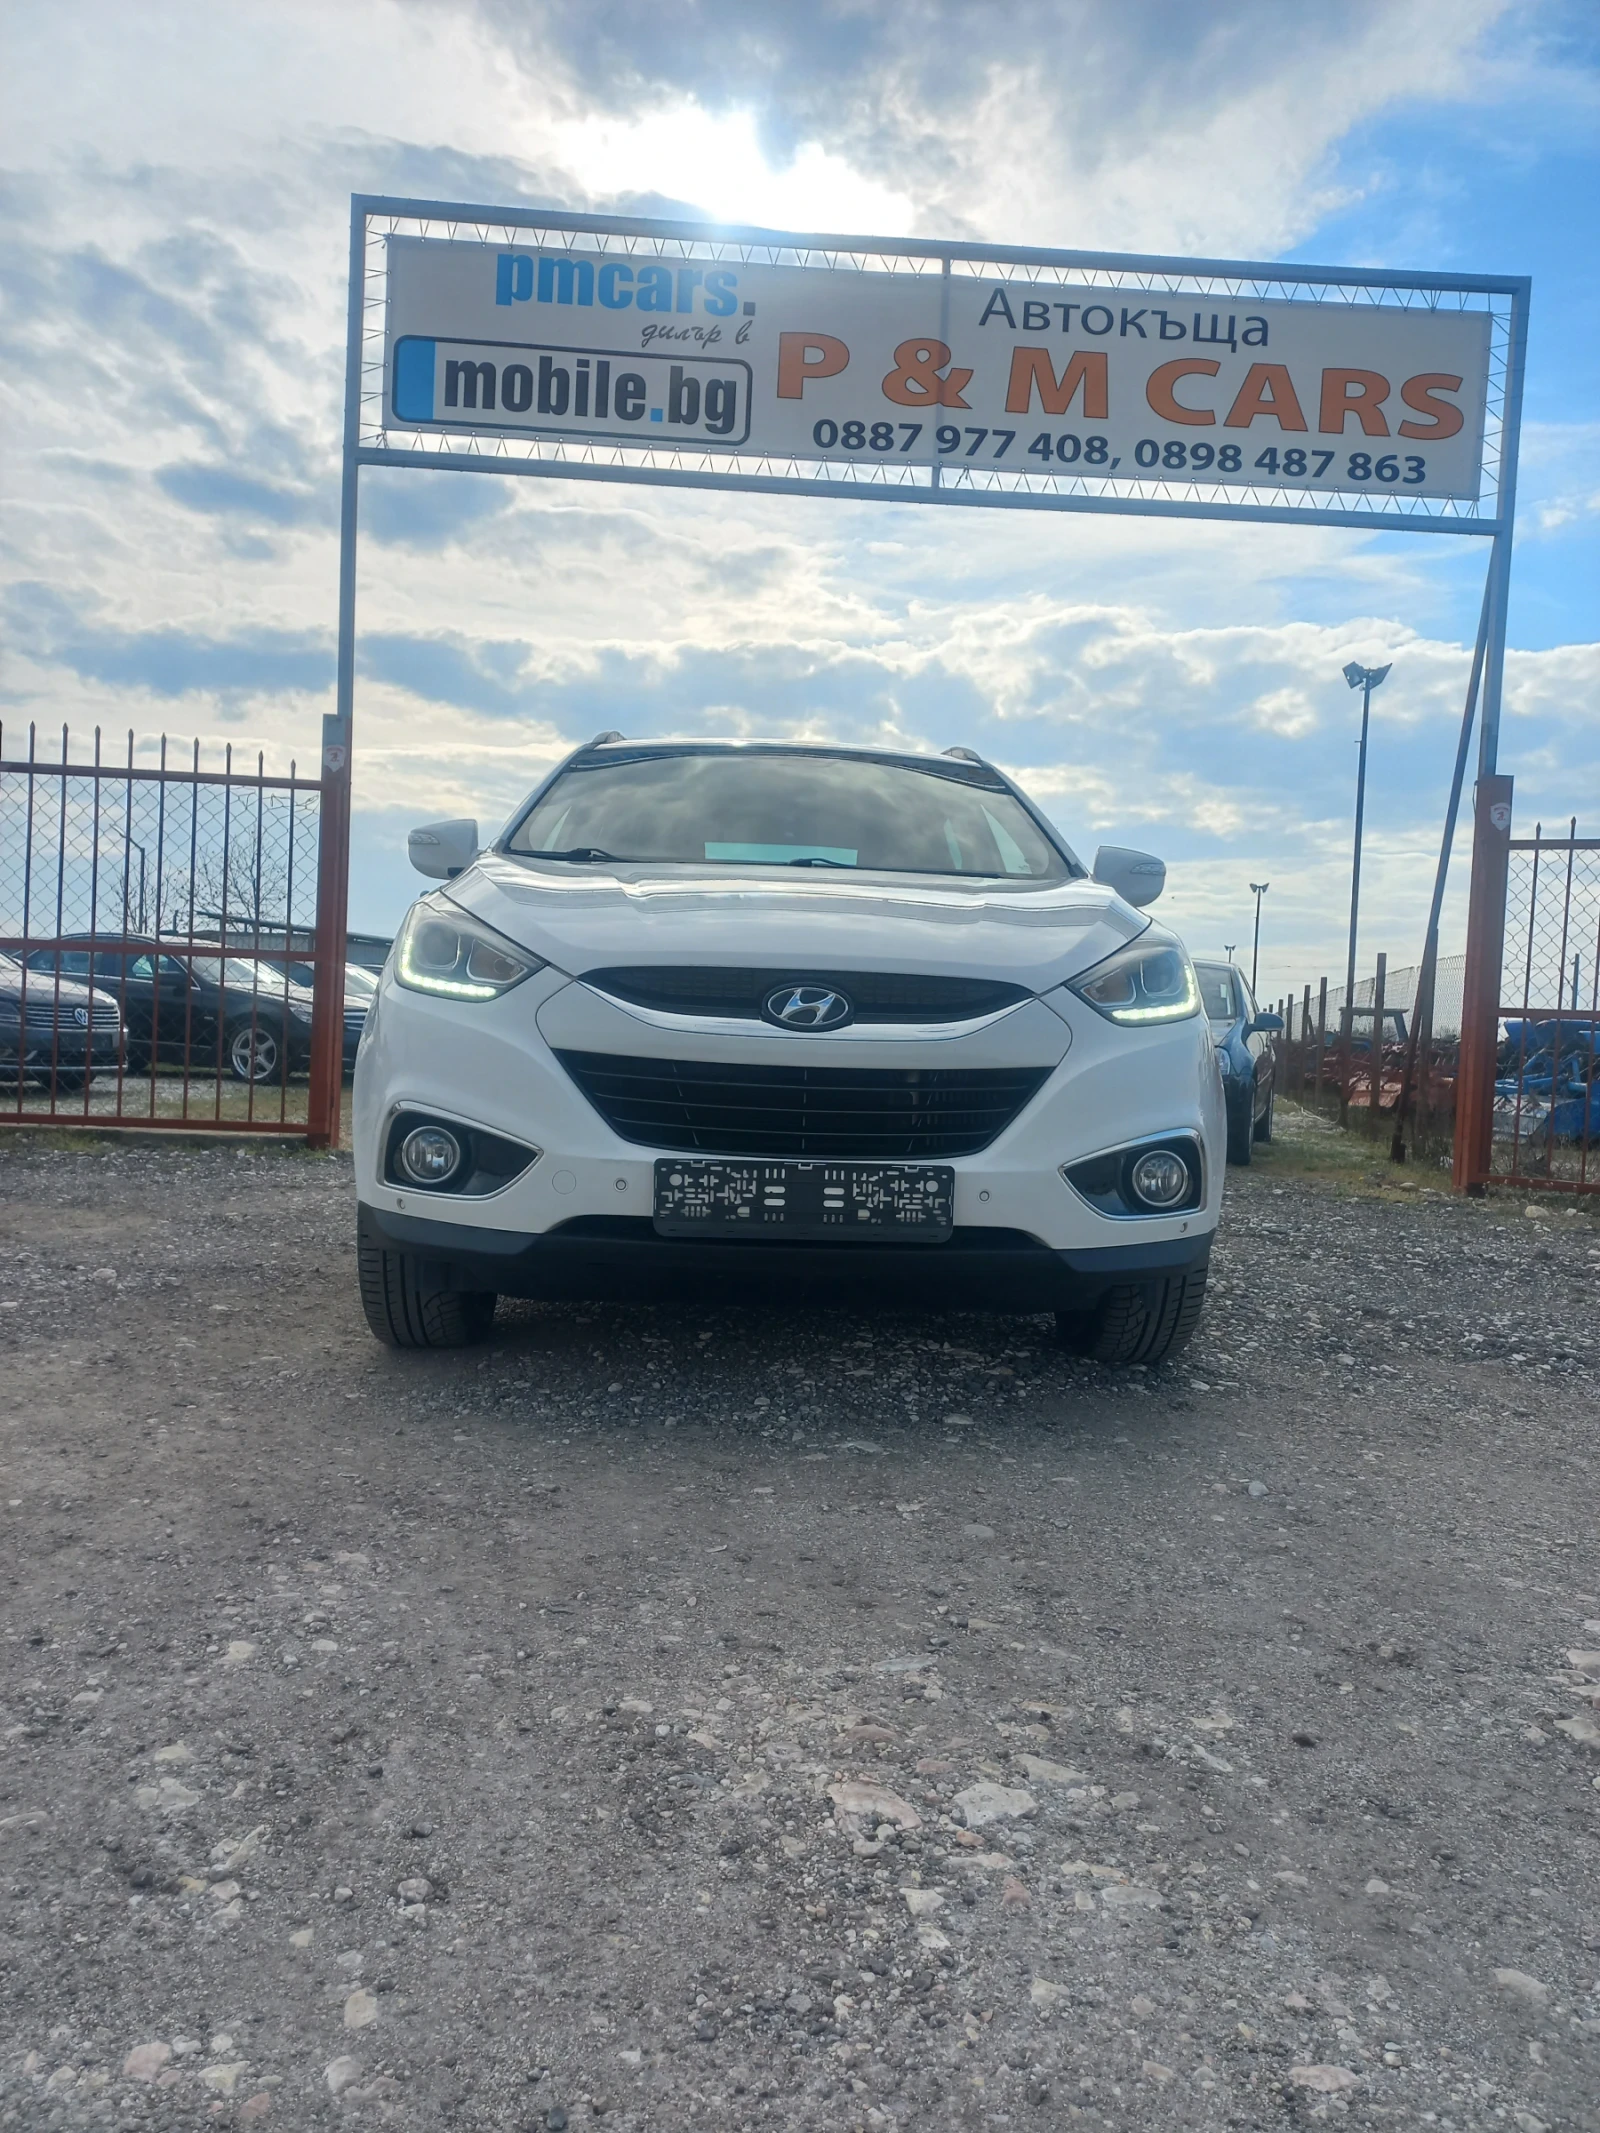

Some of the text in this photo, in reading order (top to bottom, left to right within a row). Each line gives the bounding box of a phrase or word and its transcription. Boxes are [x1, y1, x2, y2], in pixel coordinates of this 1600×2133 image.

[641, 323, 722, 349] дилър
[979, 288, 1269, 353] Автокъща
[444, 356, 737, 434] mobile.bg
[777, 332, 1465, 440] P & M CARS
[812, 418, 1427, 484] 0887 977 408, 0898 487 863
